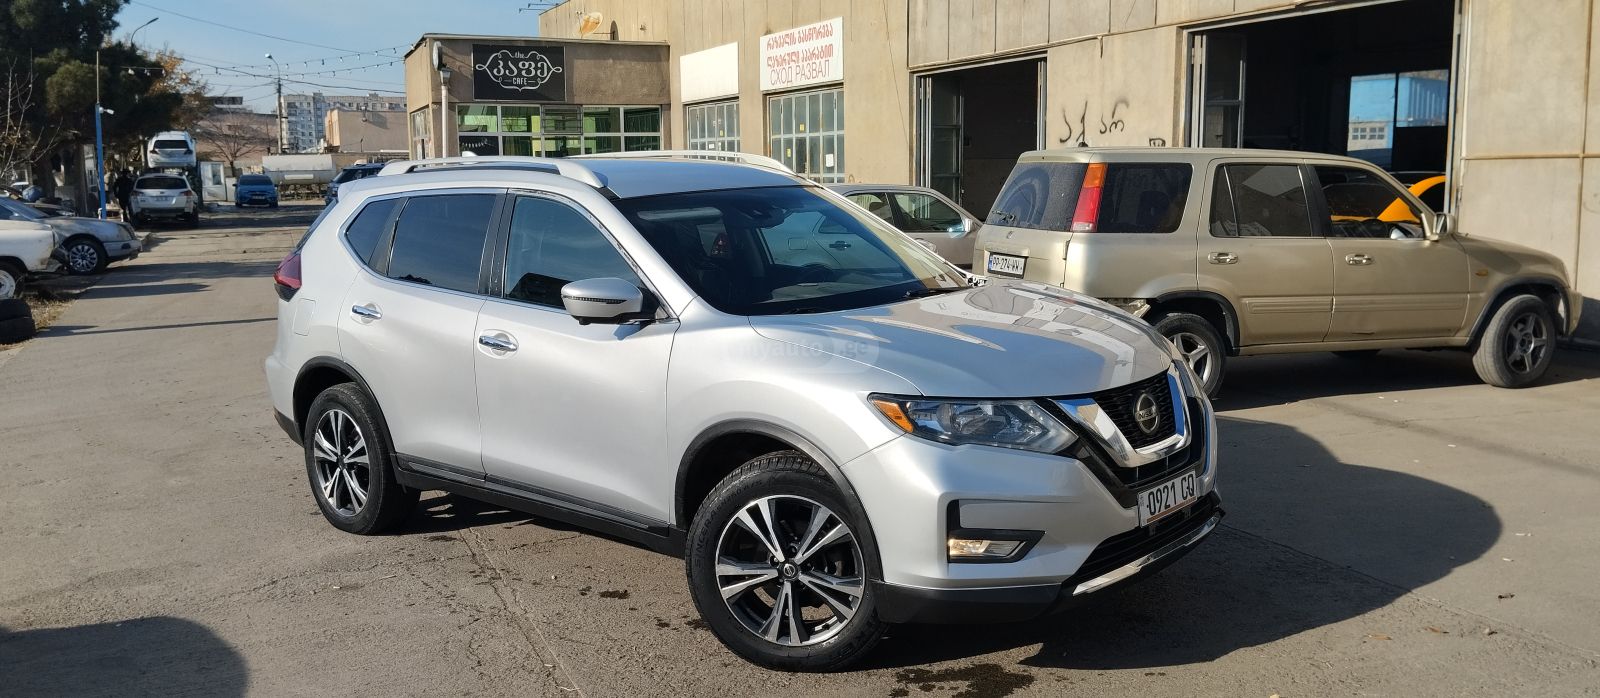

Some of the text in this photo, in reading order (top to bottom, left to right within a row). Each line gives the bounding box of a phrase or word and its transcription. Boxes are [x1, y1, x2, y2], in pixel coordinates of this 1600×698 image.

[493, 60, 548, 78] კაფე
[770, 59, 830, 86] СХОД РАЗВАЛ
[512, 77, 528, 85] CAFE
[1147, 481, 1177, 516] 0921
[1181, 473, 1195, 500] CQ
